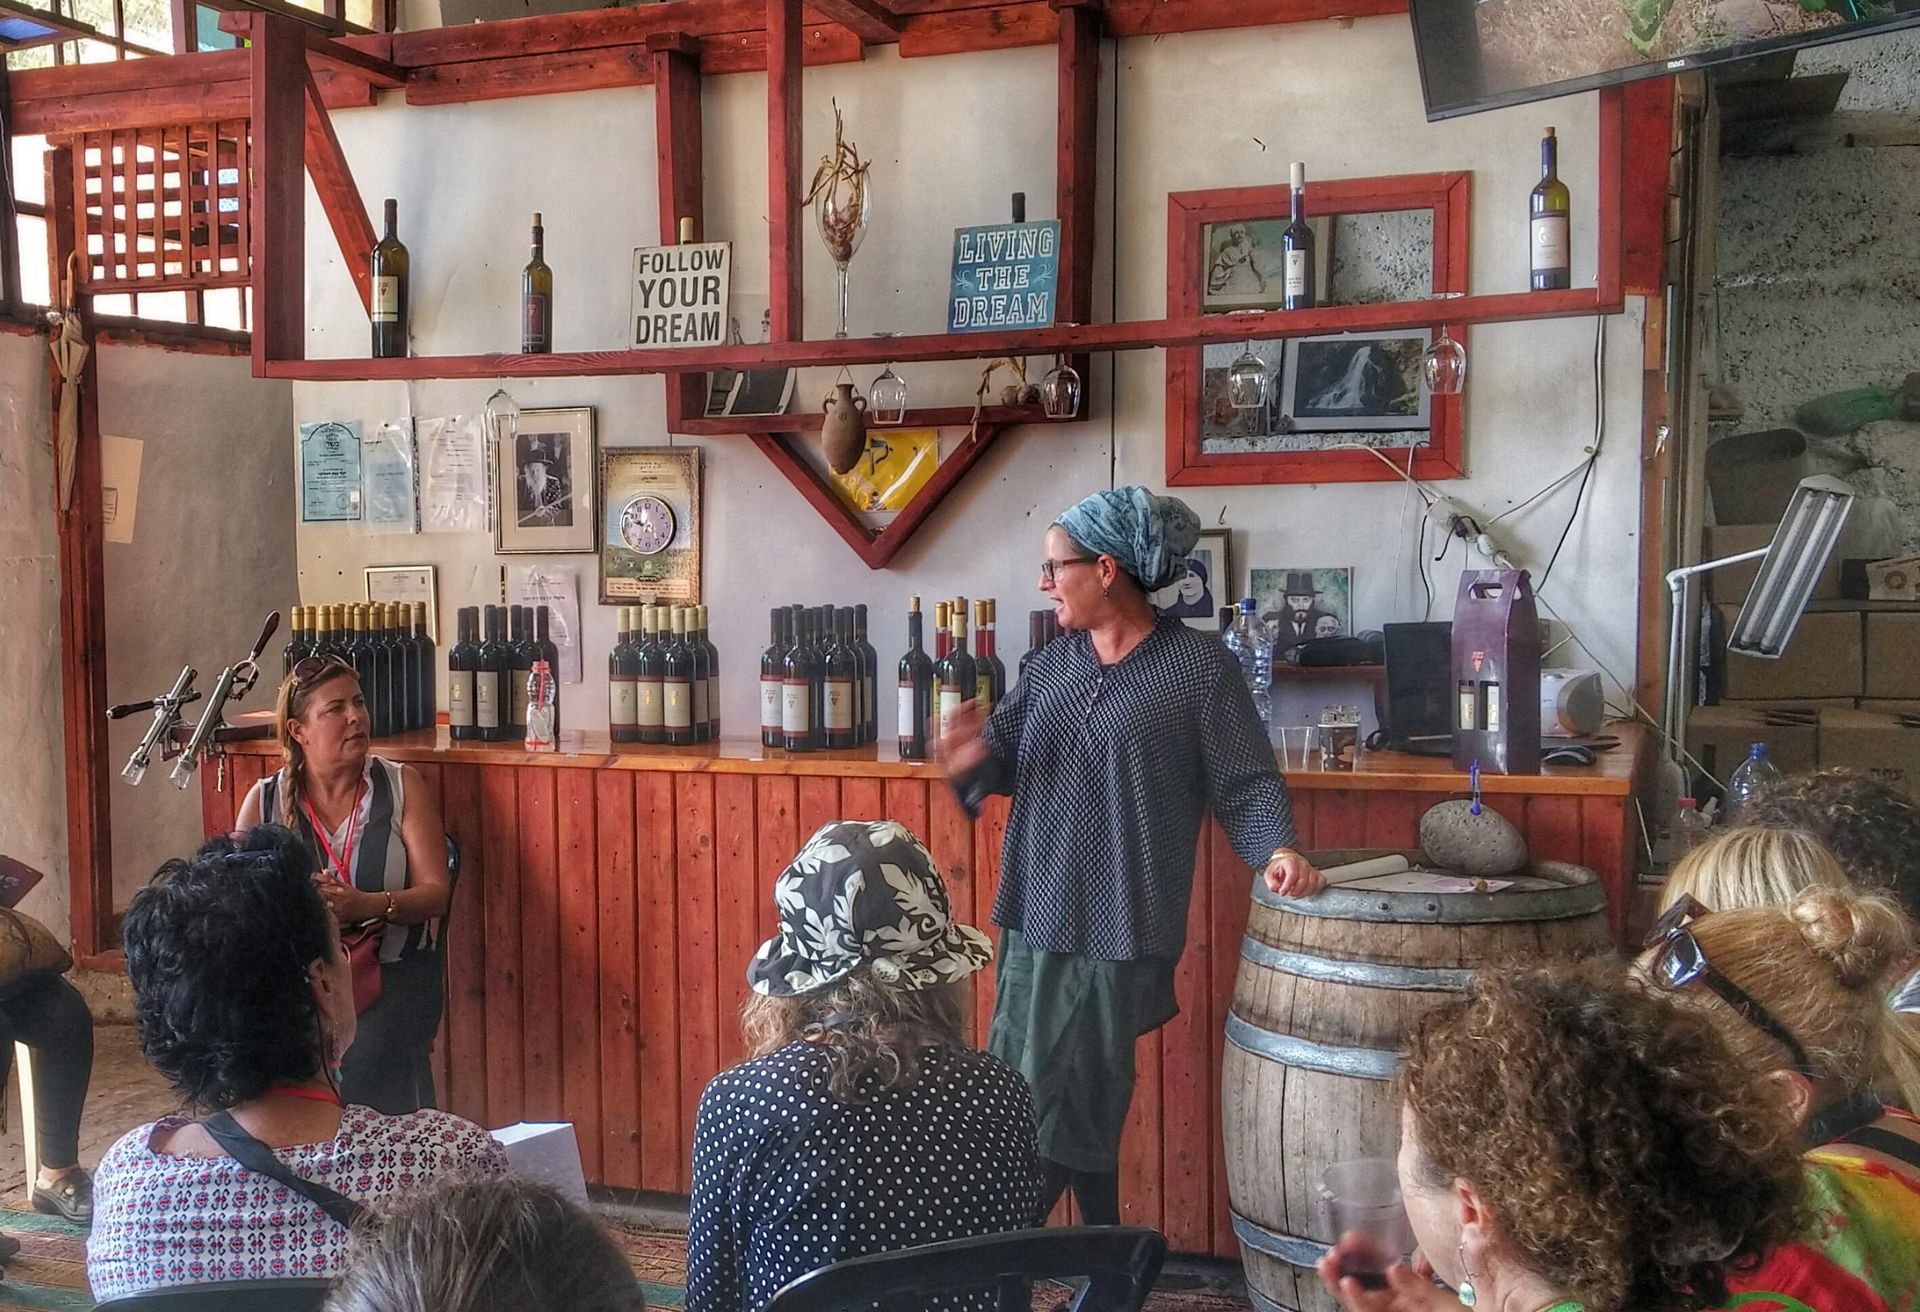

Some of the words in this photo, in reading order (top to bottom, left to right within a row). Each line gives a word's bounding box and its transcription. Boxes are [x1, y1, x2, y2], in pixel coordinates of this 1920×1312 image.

[639, 249, 724, 274] FOLLOW
[958, 227, 1054, 264] LIVING
[638, 275, 720, 309] YOUR
[976, 264, 1030, 291] THE
[953, 292, 1049, 329] DREAM
[636, 311, 720, 345] DREAM
